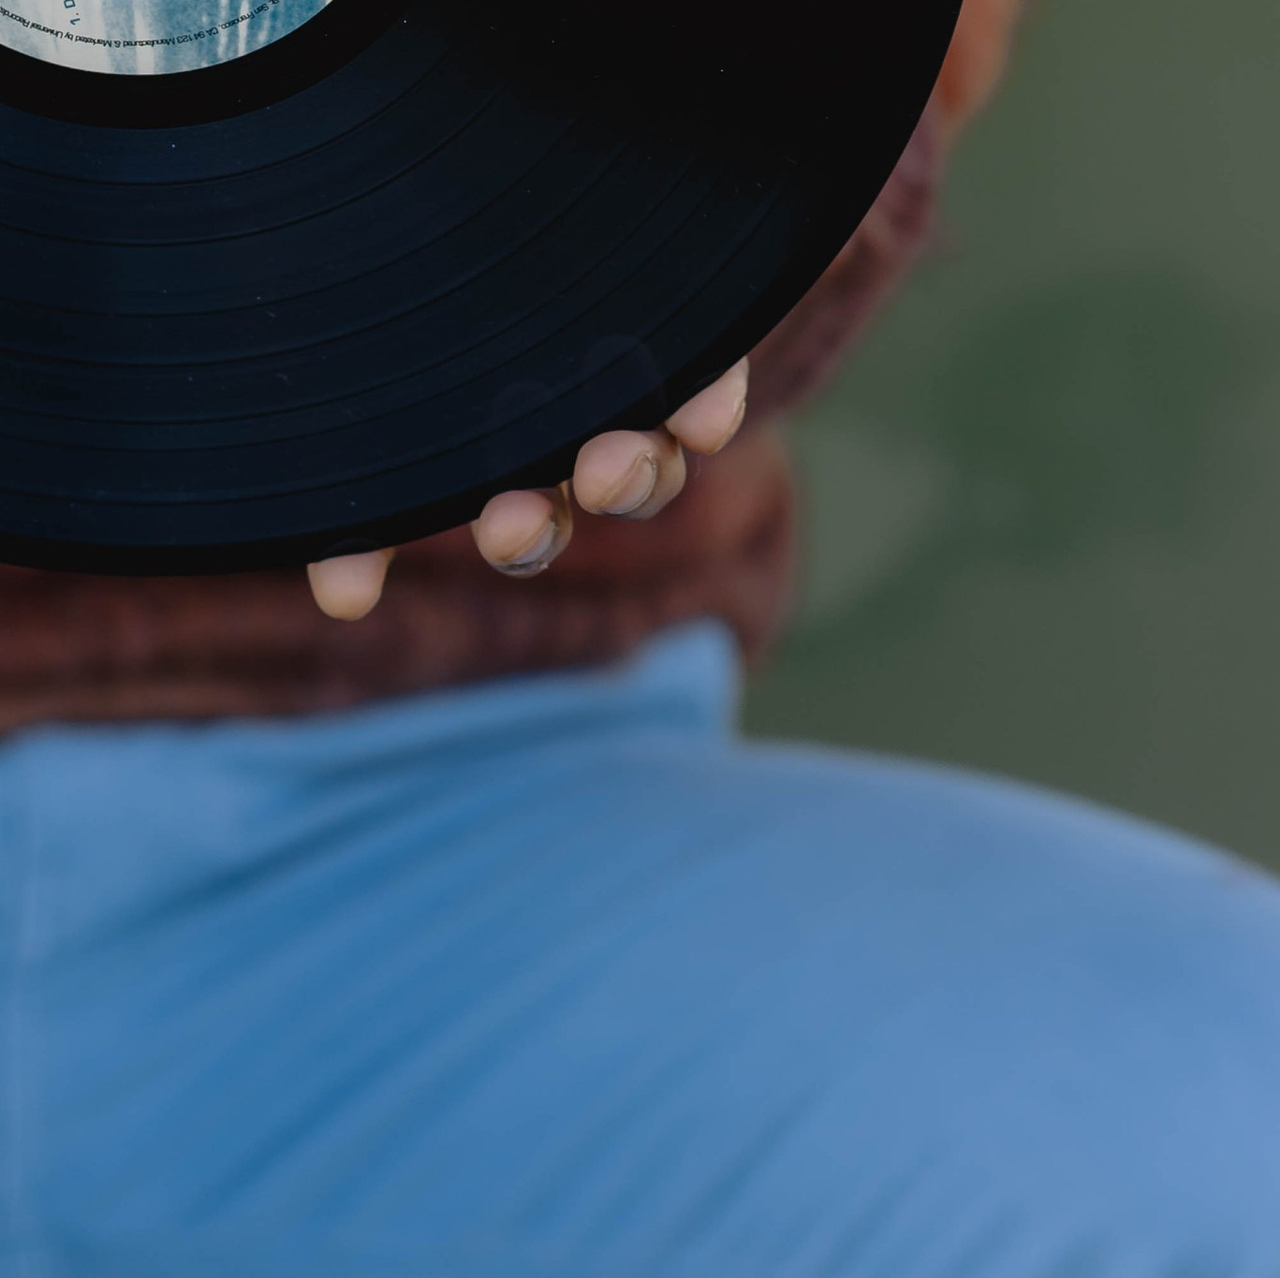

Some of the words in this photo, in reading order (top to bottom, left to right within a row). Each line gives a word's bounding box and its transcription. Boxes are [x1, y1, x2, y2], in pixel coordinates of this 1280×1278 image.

[253, 2, 269, 14] San
[69, 12, 81, 26] 1.
[29, 21, 63, 38] Universal
[205, 26, 219, 36] CA
[63, 31, 74, 41] by
[74, 34, 112, 47] Marketed
[113, 39, 121, 48] &
[122, 37, 175, 47] Manufactured
